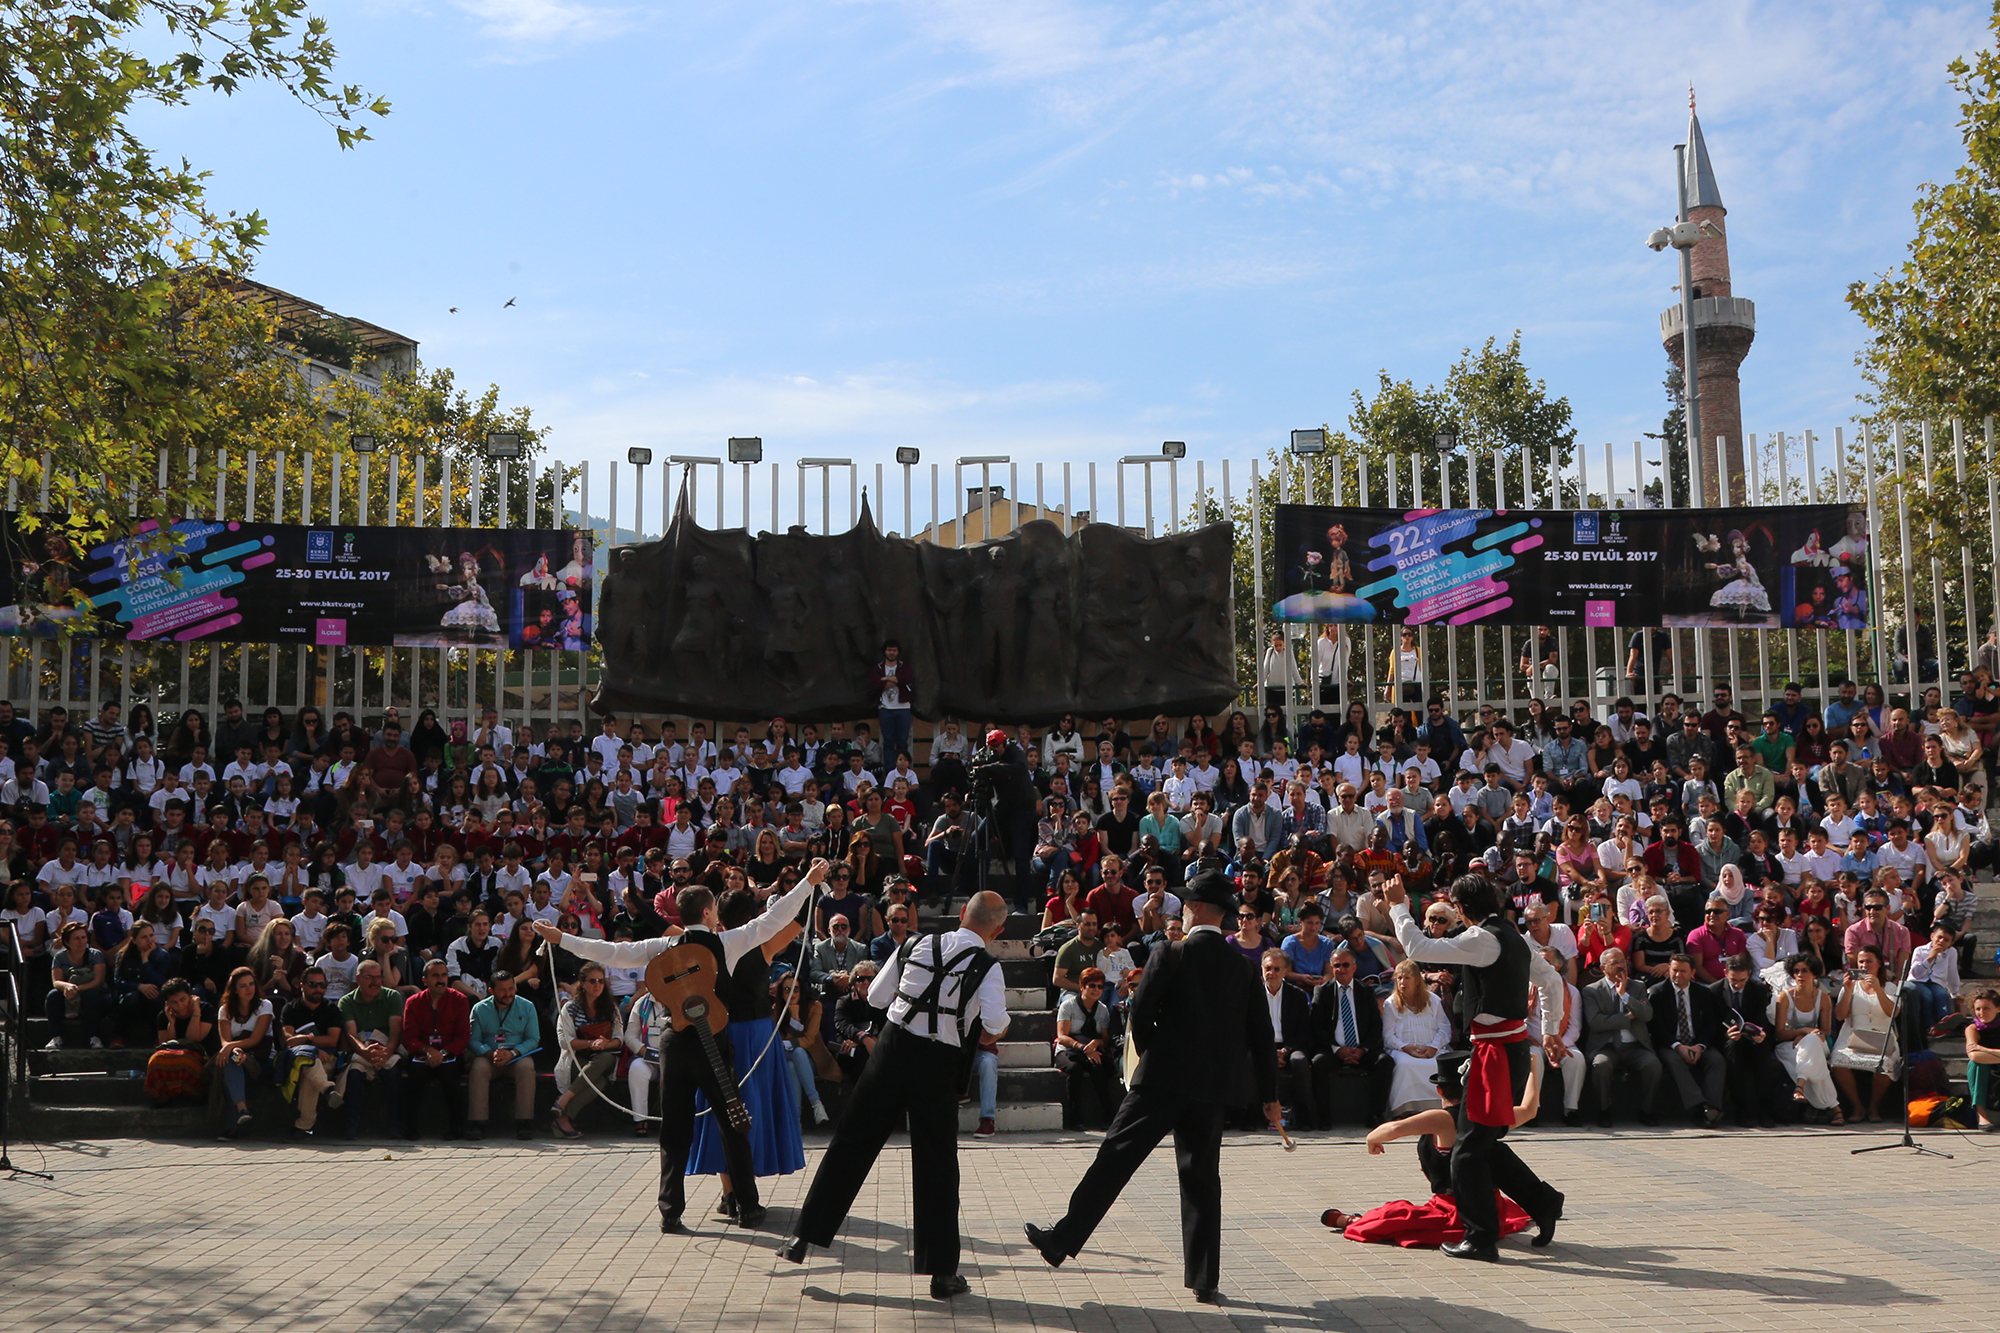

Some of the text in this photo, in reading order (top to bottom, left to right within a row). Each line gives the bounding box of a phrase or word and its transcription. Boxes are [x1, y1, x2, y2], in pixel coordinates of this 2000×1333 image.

[1389, 512, 1484, 556] 22. ULUSLARARASI
[1396, 548, 1438, 570] BURSA
[1544, 549, 1658, 561] 25-30 EYLÜL 2017
[276, 568, 390, 580] 25-30 EYLÜL 2017
[1402, 558, 1452, 582] ÇOCUK ve
[1406, 568, 1451, 592] GENÇLİK
[1409, 560, 1503, 600] TİYATROLARI FESTİVALİ
[133, 576, 232, 615] TİYATROLARI FESTİVALİ
[1422, 587, 1485, 614] BURSA THEATER FESTIVAL
[1428, 604, 1452, 617] CHILDREN
[1475, 589, 1495, 600] PEOPLE
[1439, 584, 1477, 601] INTERNATIONAL
[146, 602, 214, 628] BURSA THEATER FESTIVAL
[153, 620, 179, 632] CHILDREN
[203, 604, 224, 615] PEOPLE
[164, 600, 205, 616] INTERNATIONAL
